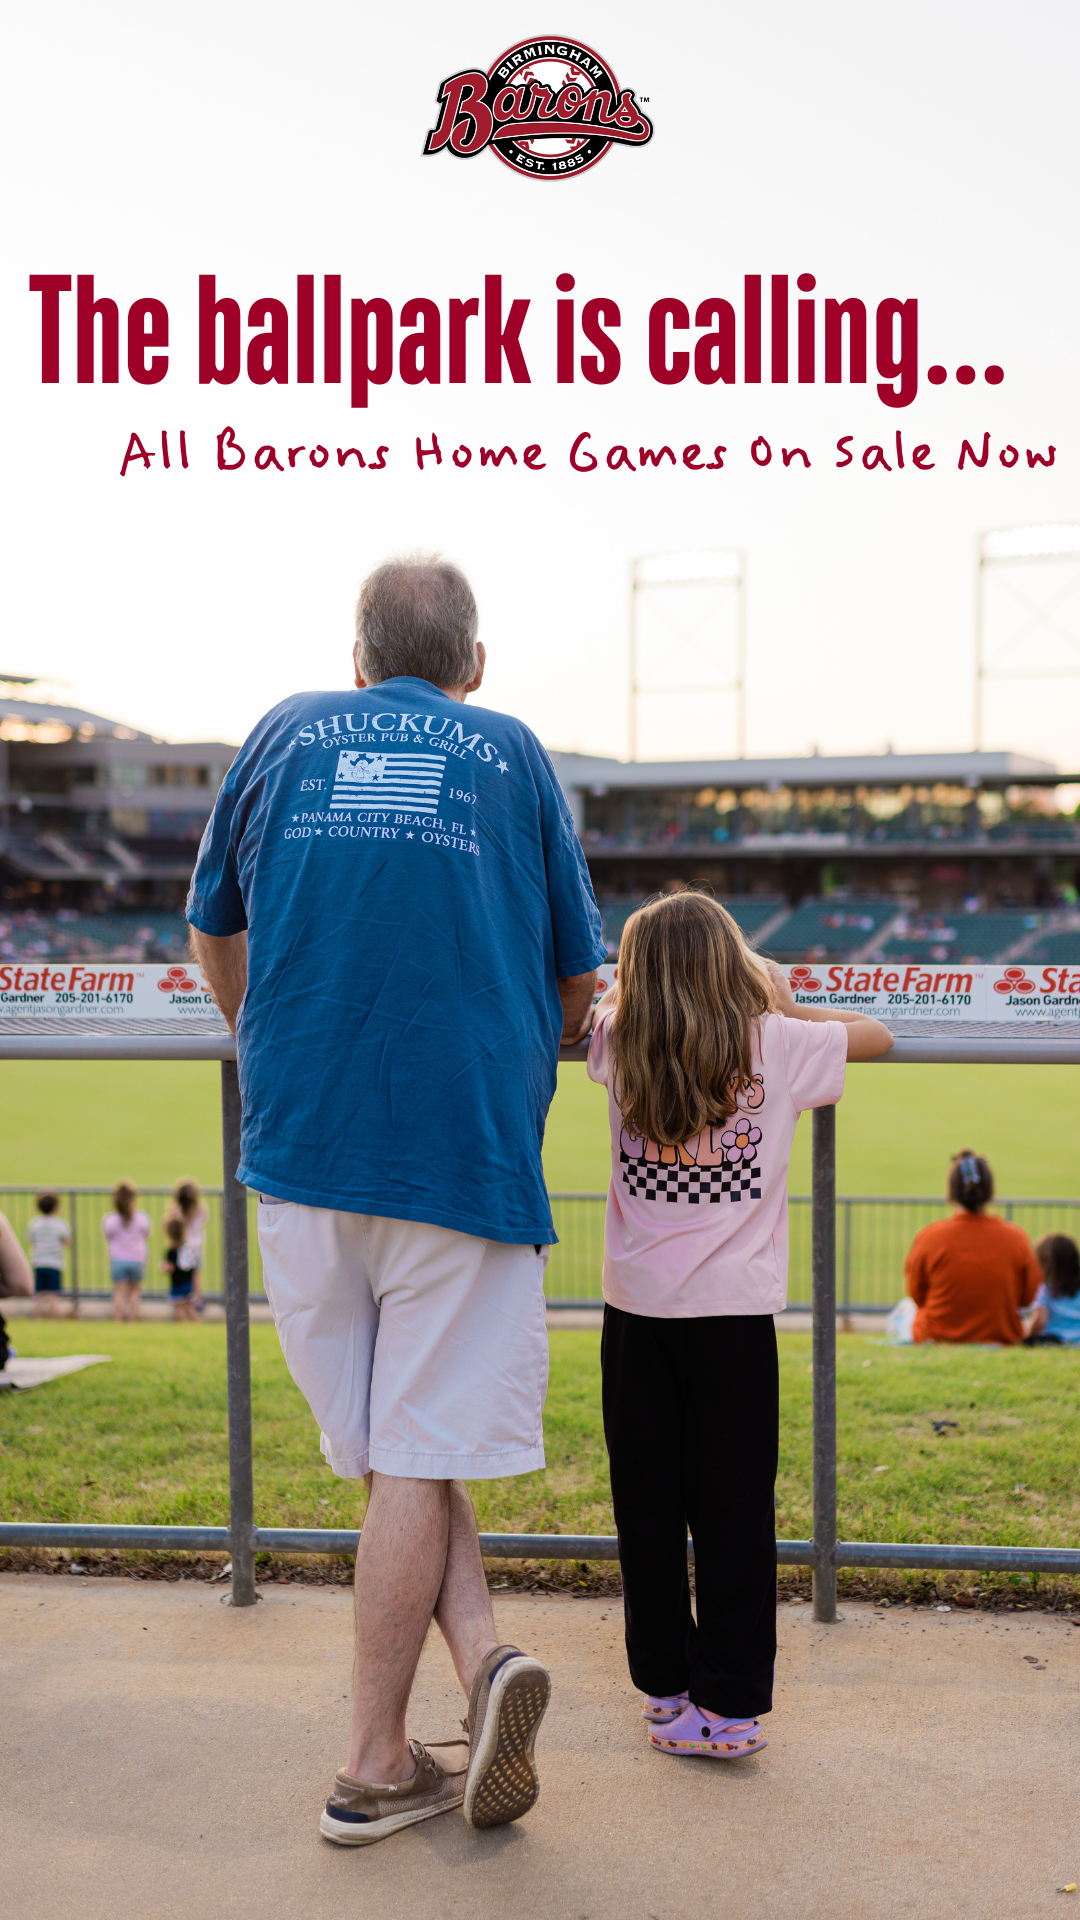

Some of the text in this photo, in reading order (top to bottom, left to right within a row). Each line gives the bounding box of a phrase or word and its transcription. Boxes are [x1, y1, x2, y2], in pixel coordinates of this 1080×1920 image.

[298, 712, 499, 763] SHUCKUMS
[322, 732, 467, 760] OYSTER PUB & GRILL
[300, 778, 327, 792] EST.
[448, 787, 478, 805] 1967
[301, 812, 467, 836] PANAMA CITY BEACH, FL
[284, 825, 480, 857] GOD COUNTRY OYSTERS
[0, 992, 134, 1004] Gardner 205-201-6170
[169, 993, 202, 1004] Jason
[795, 993, 971, 1005] Jason Gardner 205-201-6170
[1005, 994, 1080, 1006] Jason Gardn
